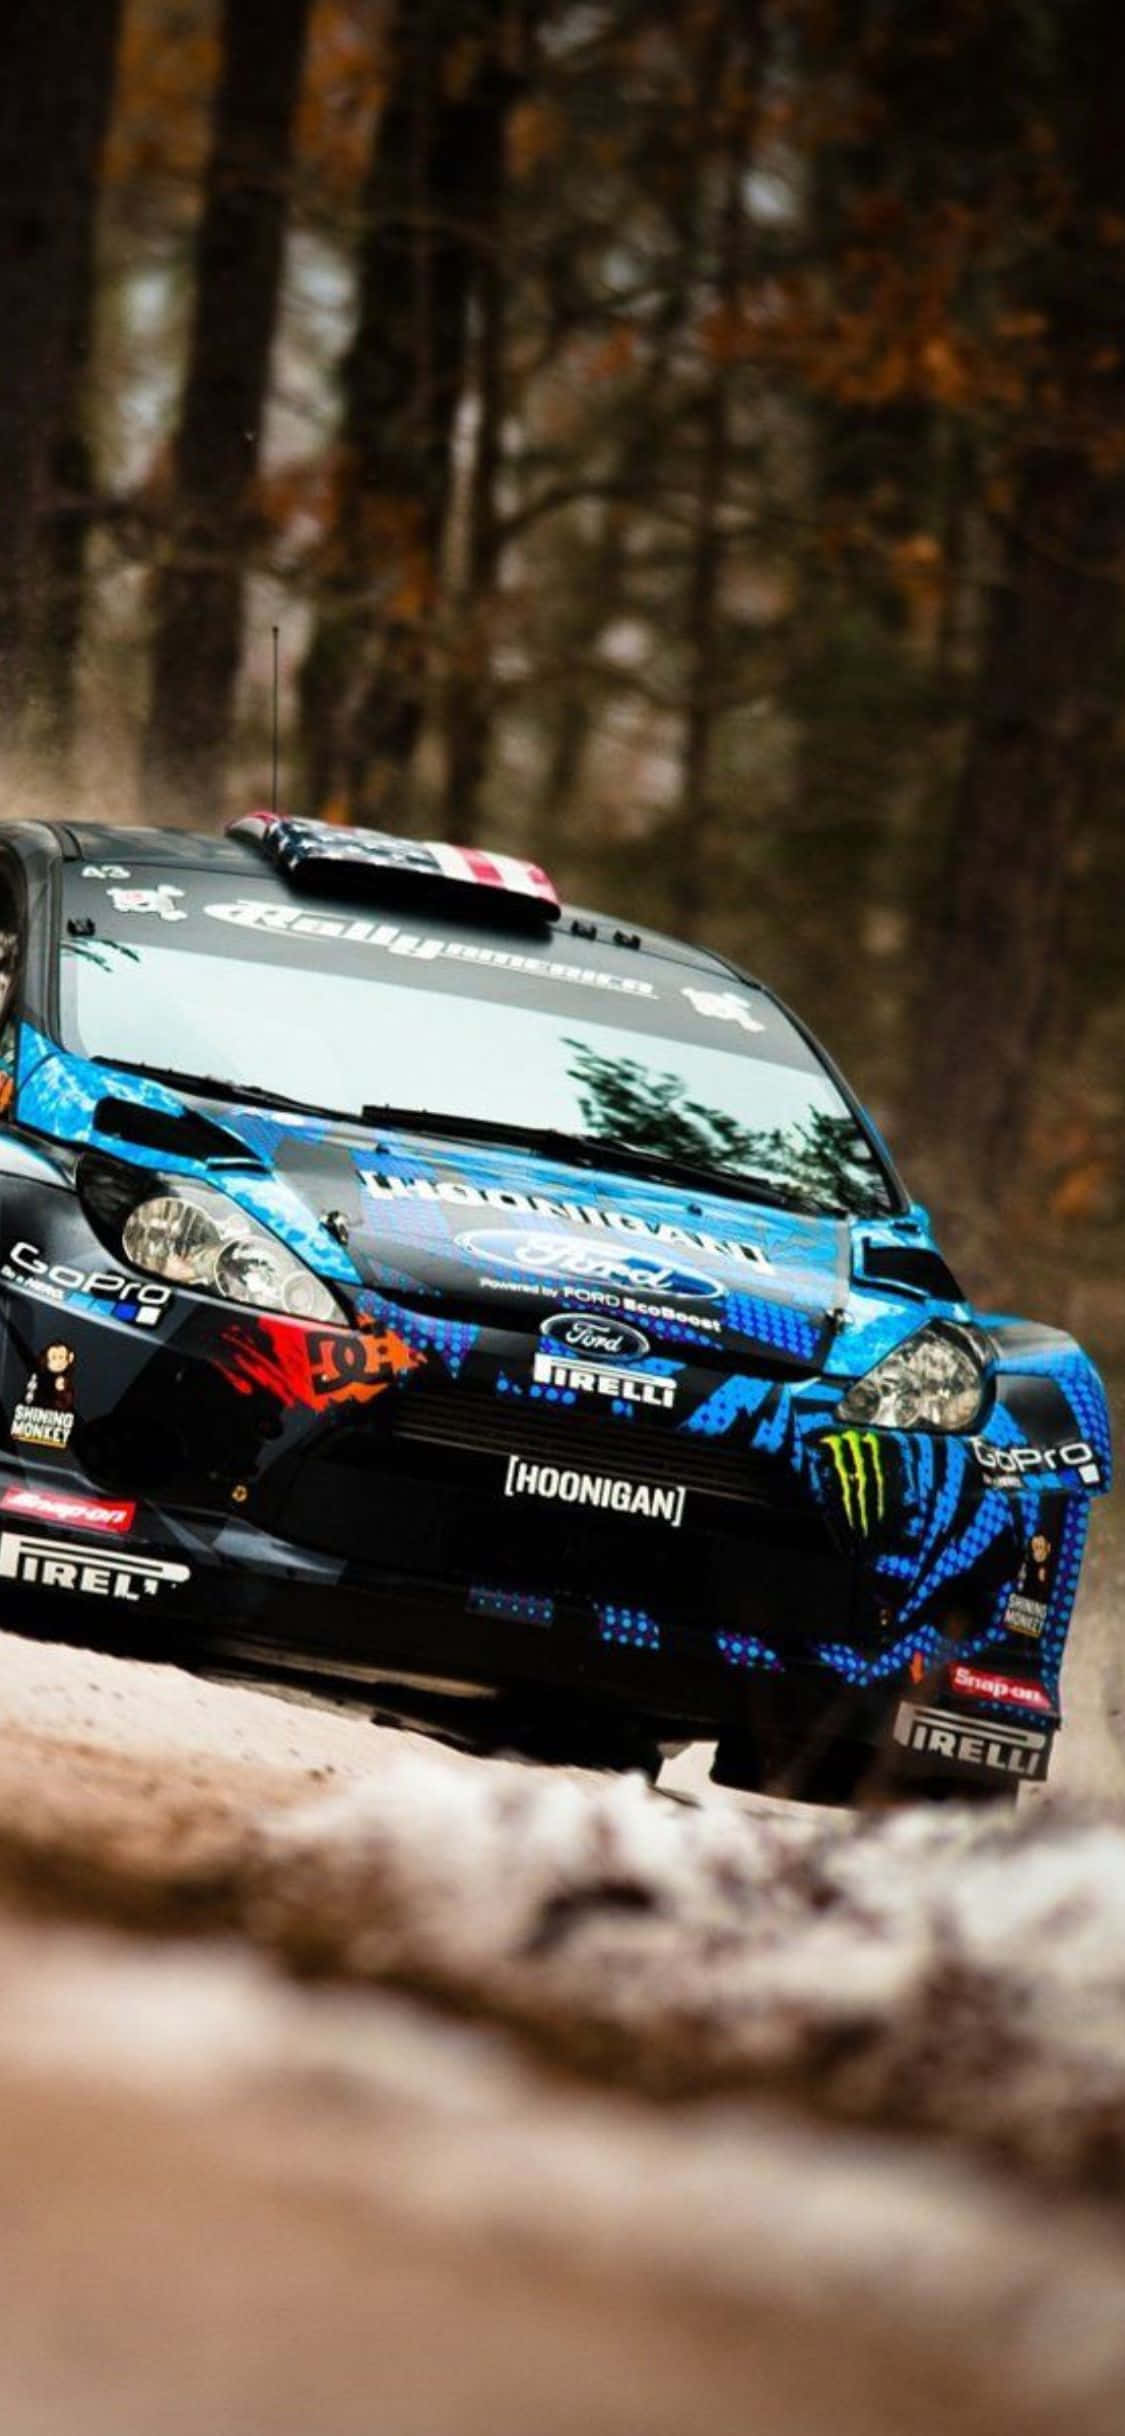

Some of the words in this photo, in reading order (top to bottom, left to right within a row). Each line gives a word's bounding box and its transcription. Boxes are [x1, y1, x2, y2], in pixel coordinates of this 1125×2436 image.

[9, 1241, 172, 1305] GoPro
[480, 1278, 540, 1295] Powered
[543, 1285, 558, 1298] by
[563, 1286, 621, 1308] FORD
[623, 1298, 721, 1333] EcoBoost
[565, 1320, 624, 1352] Ford
[533, 1352, 677, 1408] PIRELLI
[10, 1420, 72, 1443] MONKEY
[15, 1403, 75, 1428] SHINING
[969, 1435, 1093, 1472] GoPro
[504, 1455, 686, 1527] [HOONIGAN]
[954, 1666, 1043, 1702] Snap-on
[893, 1701, 1047, 1776] PIRELLI
